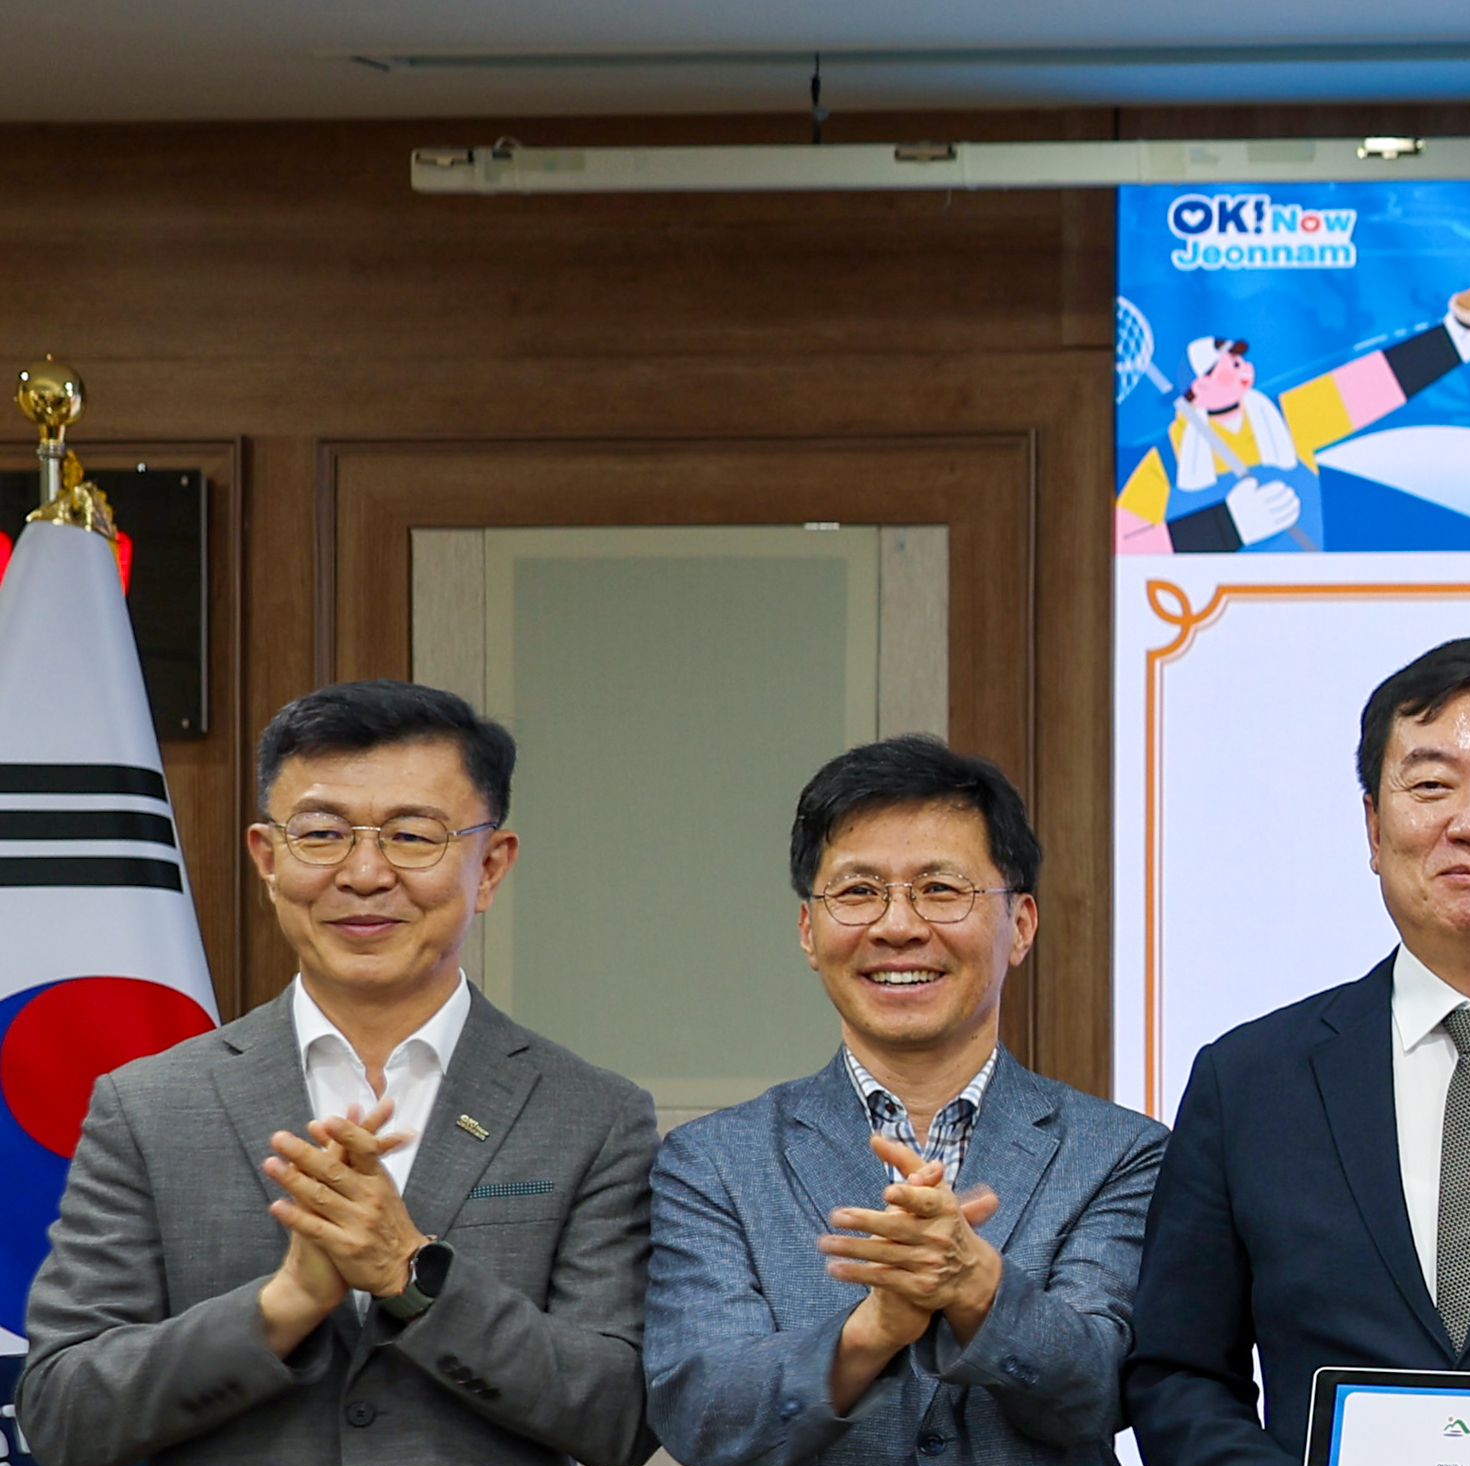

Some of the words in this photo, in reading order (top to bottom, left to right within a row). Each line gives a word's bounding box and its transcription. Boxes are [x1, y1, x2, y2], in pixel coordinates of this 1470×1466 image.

[1173, 200, 1265, 234] OK!
[1271, 208, 1351, 234] Now
[1176, 241, 1350, 265] Jeonnam
